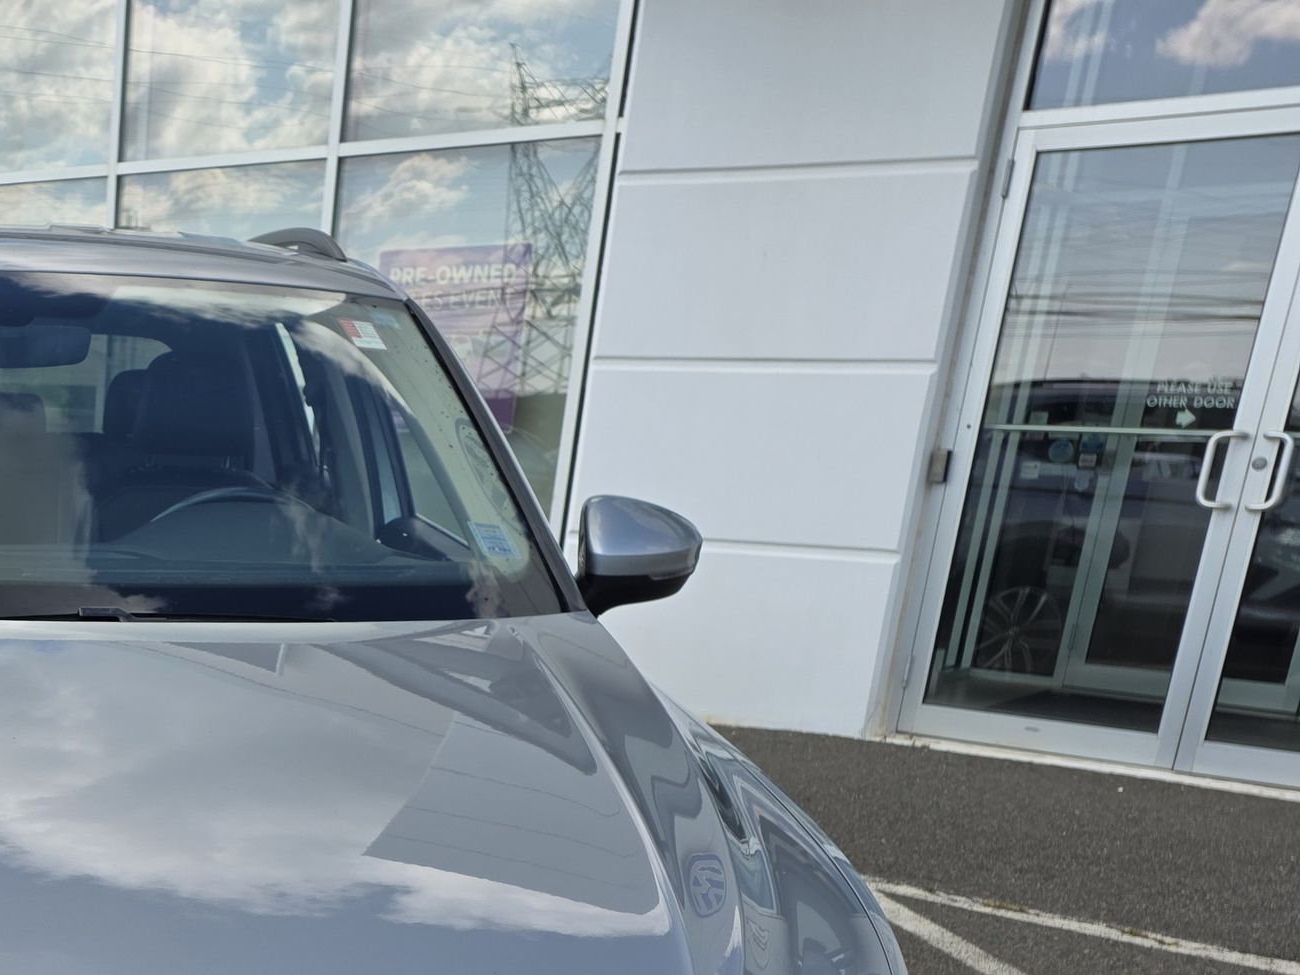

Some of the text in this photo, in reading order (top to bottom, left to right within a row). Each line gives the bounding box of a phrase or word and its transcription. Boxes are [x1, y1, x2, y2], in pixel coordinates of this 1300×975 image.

[389, 263, 517, 286] PRE-OWNED
[1156, 381, 1232, 394] PLEASE USE
[1146, 395, 1235, 409] OTHER DOOR
